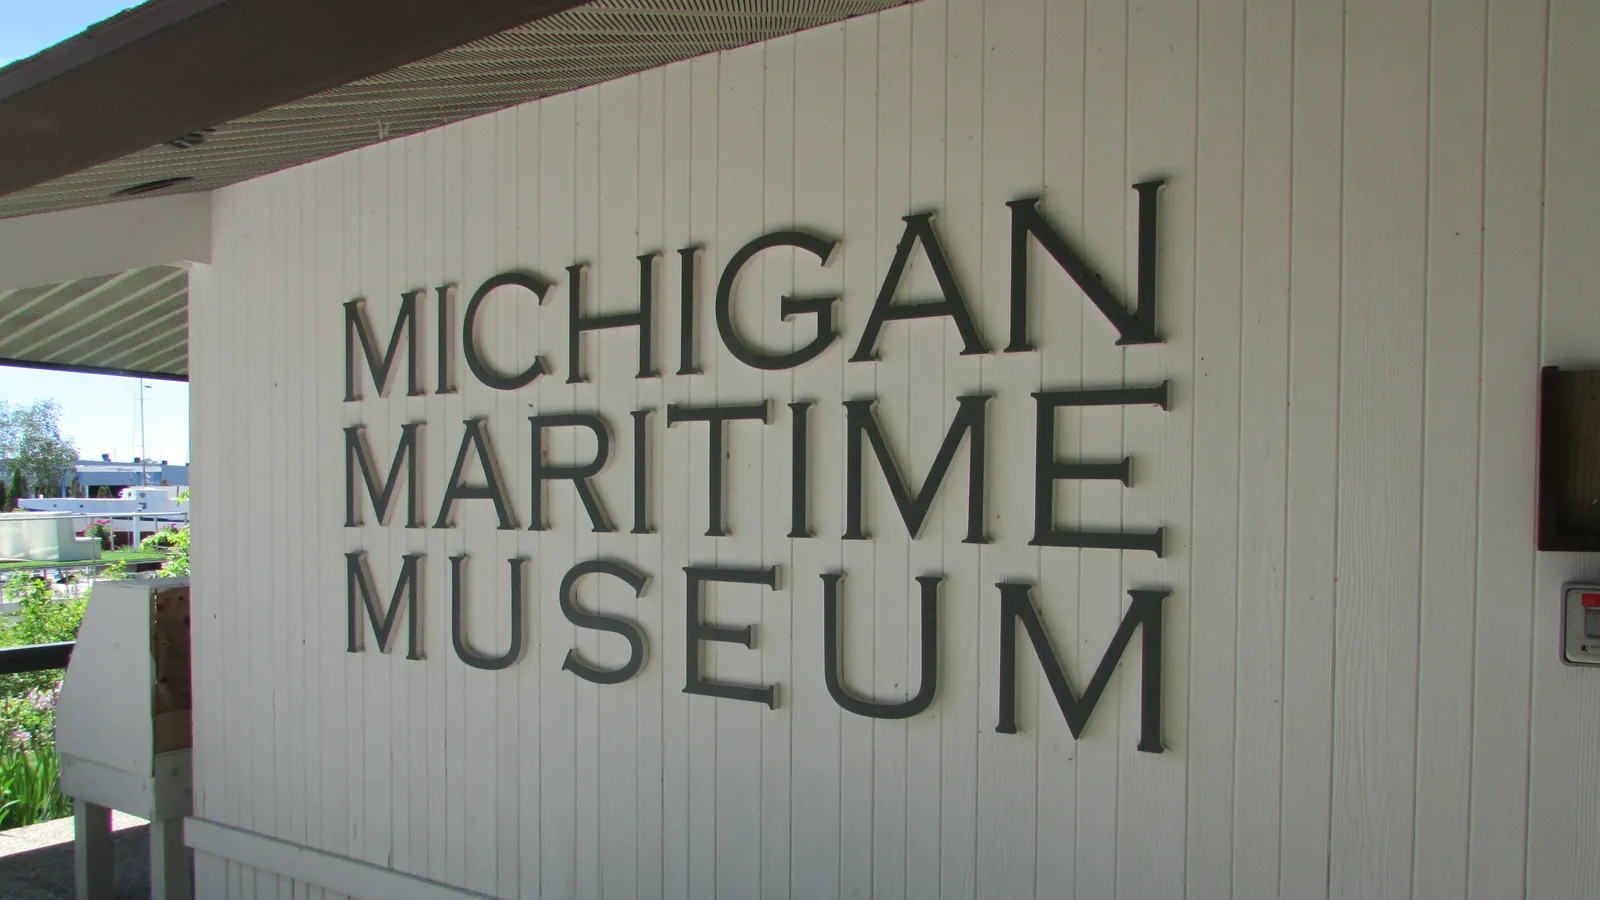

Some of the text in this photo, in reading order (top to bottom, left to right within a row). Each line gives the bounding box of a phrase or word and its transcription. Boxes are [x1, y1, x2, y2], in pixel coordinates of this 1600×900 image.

[343, 180, 1166, 402] MICHIGAN
[343, 382, 1167, 557] MARITIME
[346, 550, 1172, 754] MUSEUM
